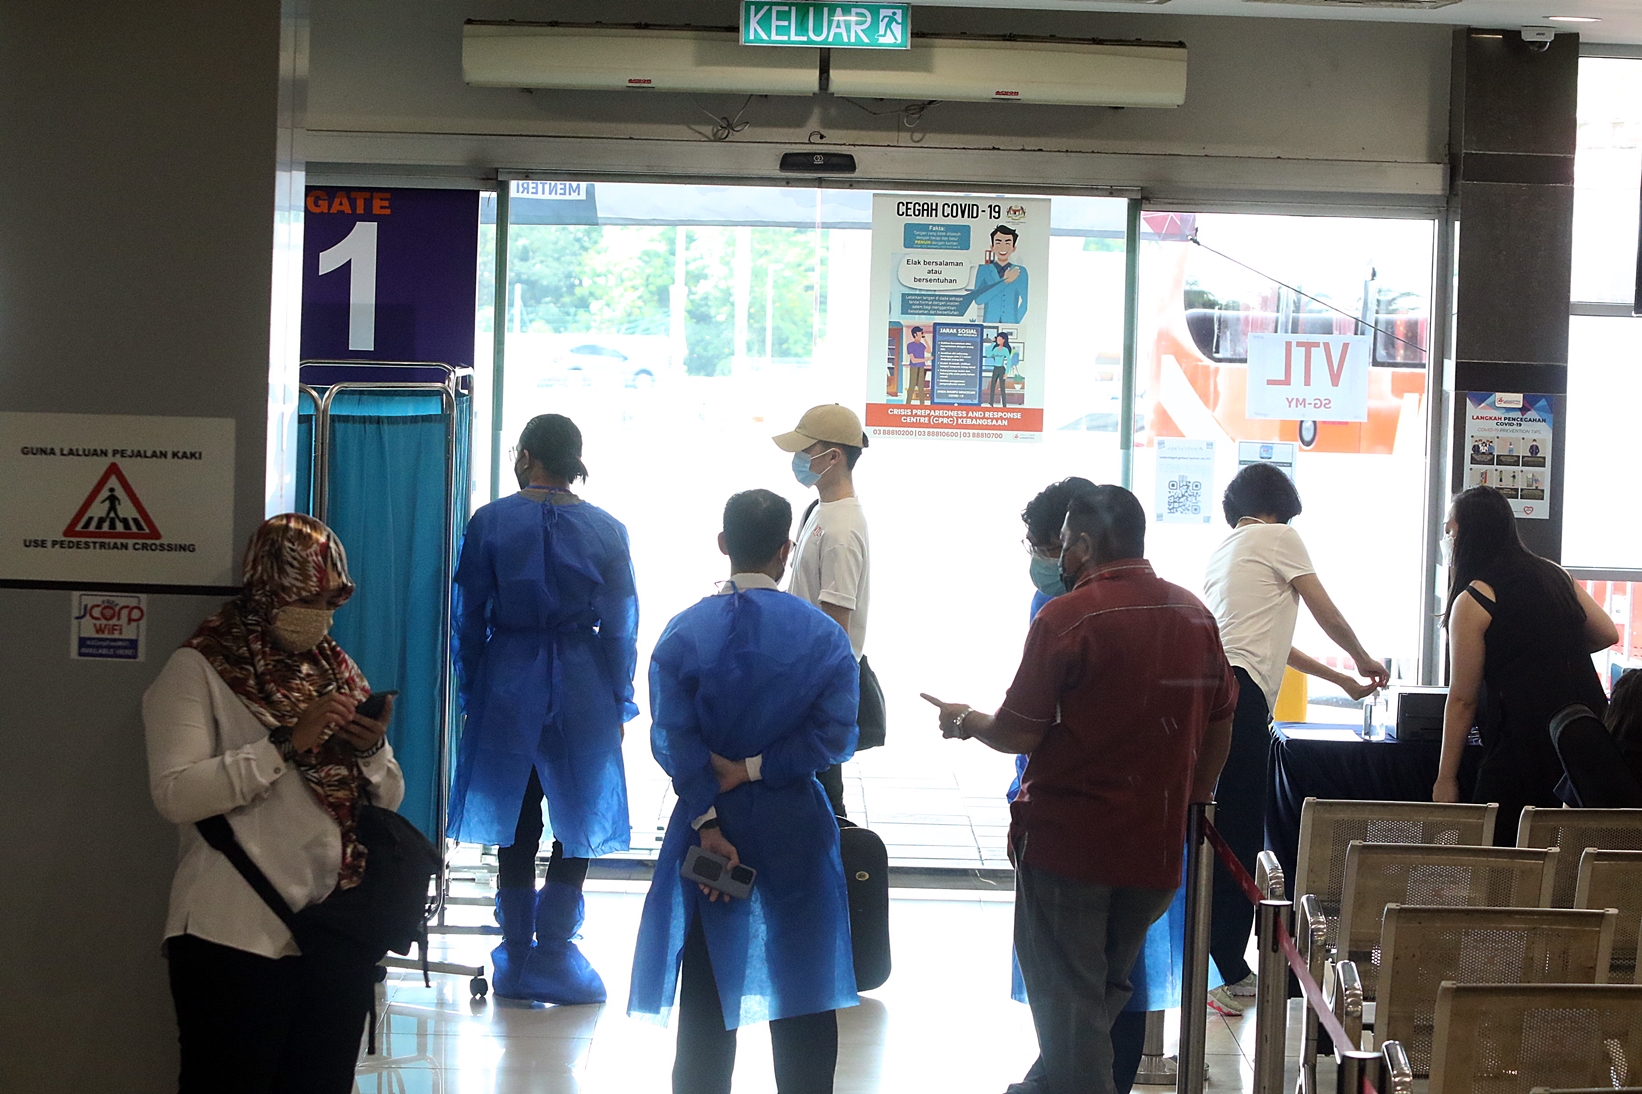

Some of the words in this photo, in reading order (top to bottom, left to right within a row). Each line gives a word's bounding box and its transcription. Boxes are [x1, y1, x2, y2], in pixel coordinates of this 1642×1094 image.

[750, 5, 872, 43] KELUAR
[306, 190, 391, 214] GATE
[897, 201, 938, 217] CEGAH
[906, 258, 921, 266] Elak
[923, 259, 963, 267] bersalaman
[319, 222, 377, 350] 1
[913, 276, 957, 284] bersentuhan
[913, 409, 967, 417] PREPAREDNESS
[930, 416, 957, 425] (CPRC)
[958, 418, 1008, 426] KEBANGSAAN
[21, 446, 56, 456] GUNA
[60, 447, 108, 458] LALUAN
[112, 448, 168, 459] PEJALAN
[172, 450, 202, 460] KAKI
[23, 539, 48, 548] USE
[51, 540, 128, 551] PEDESTRIAN
[132, 542, 196, 552] CROSSING
